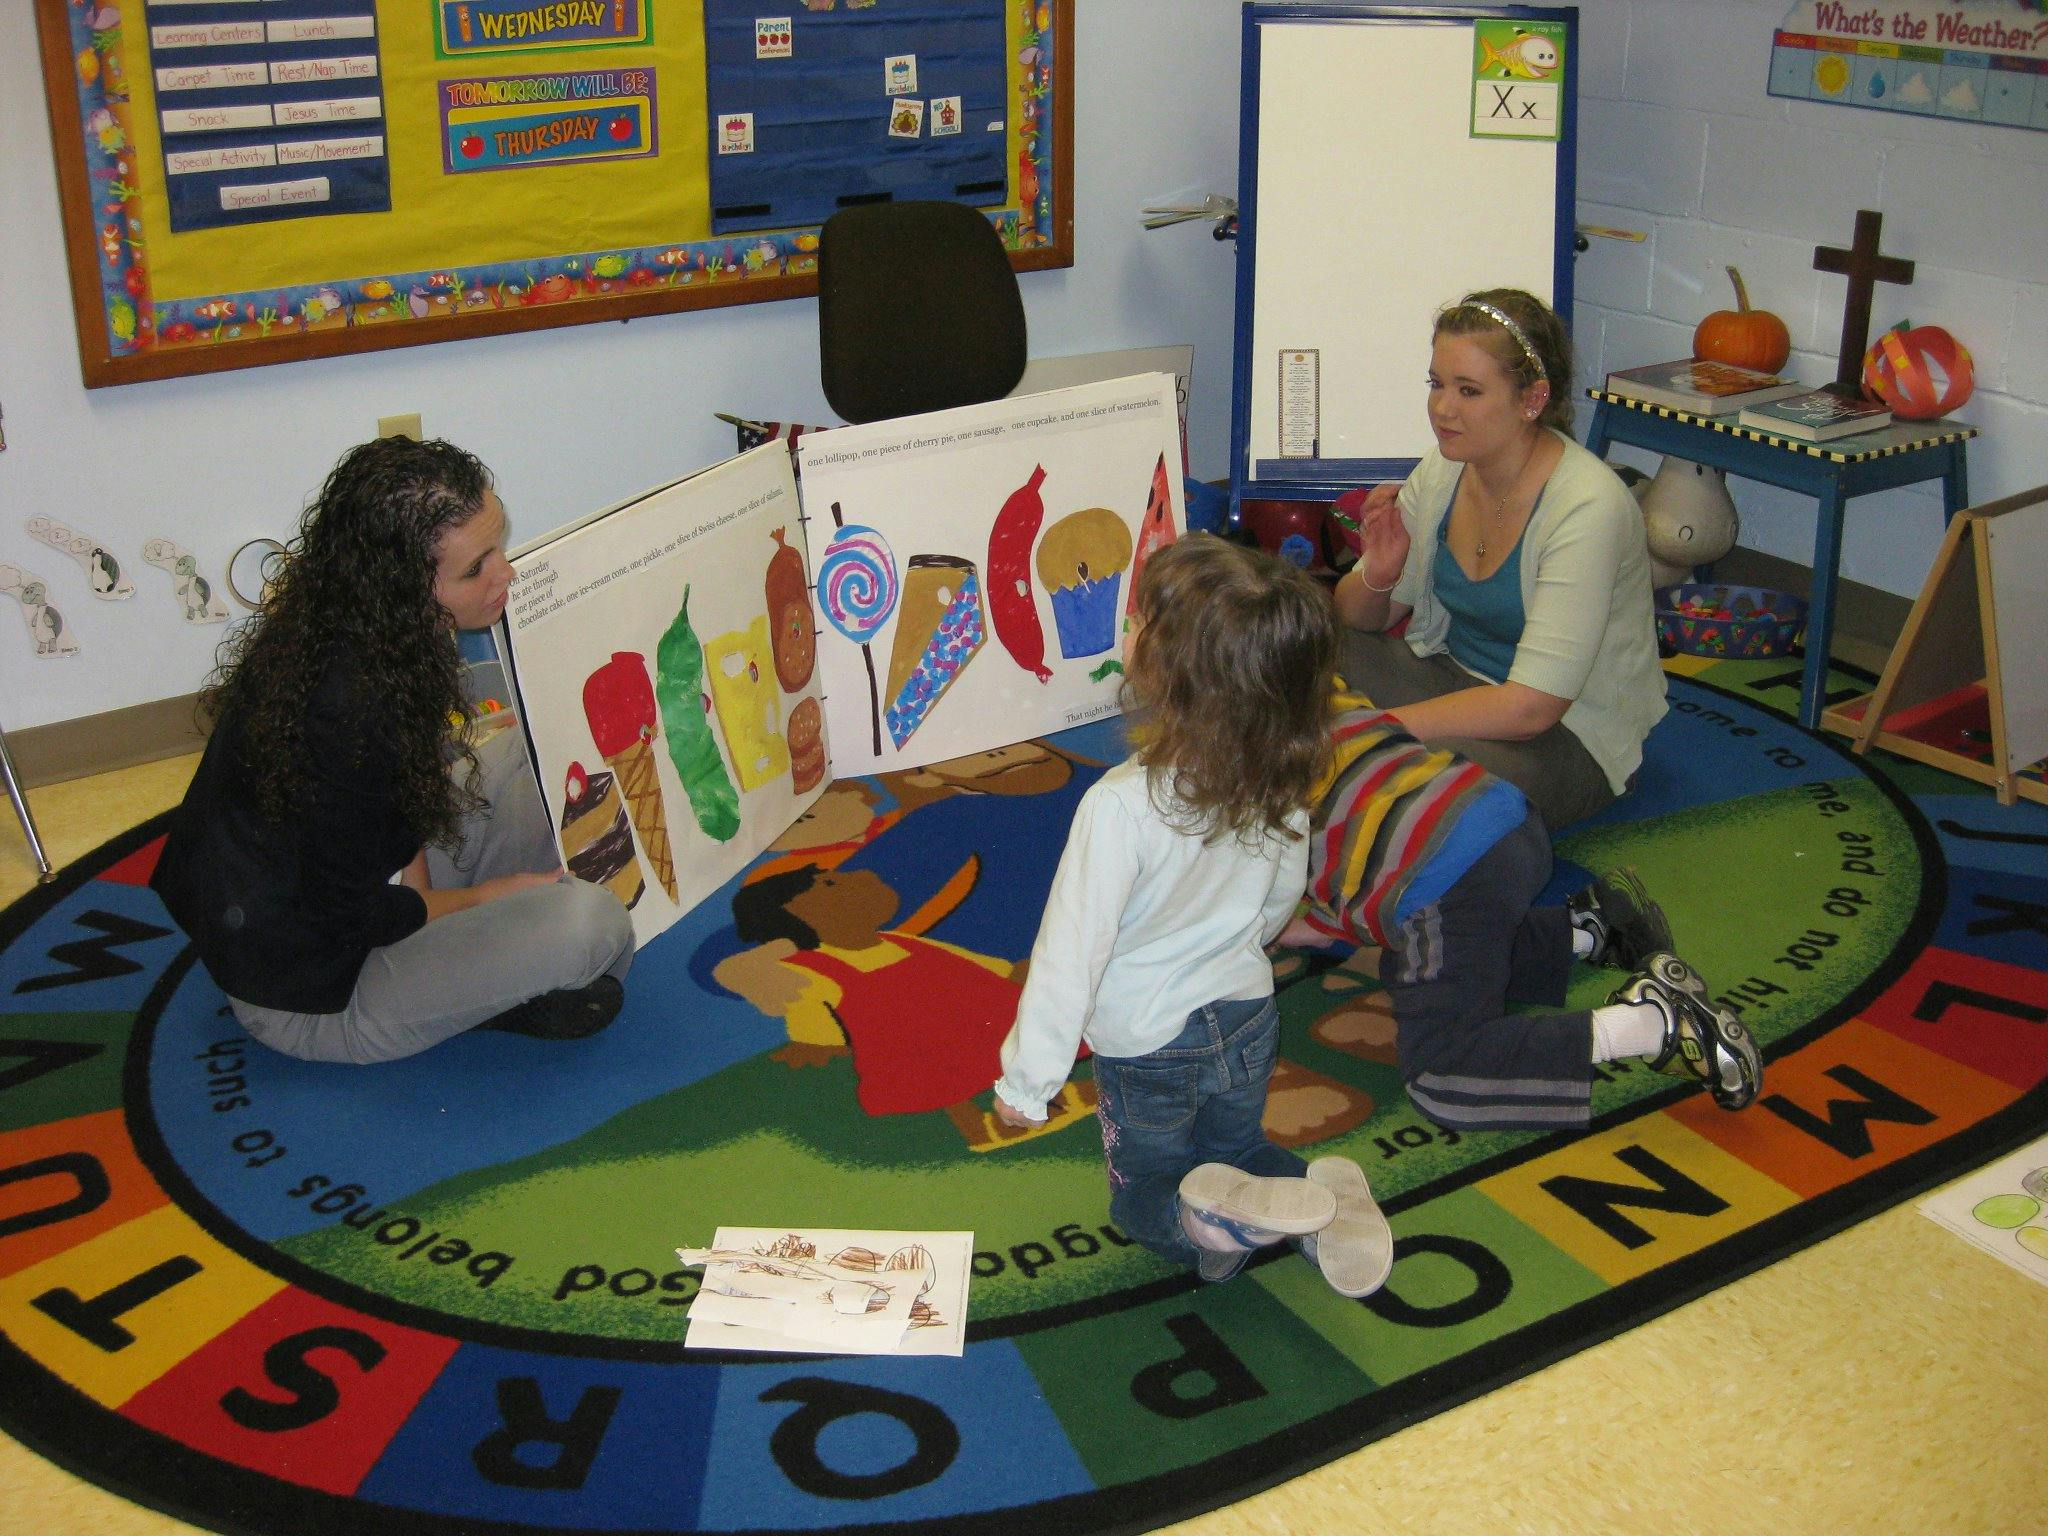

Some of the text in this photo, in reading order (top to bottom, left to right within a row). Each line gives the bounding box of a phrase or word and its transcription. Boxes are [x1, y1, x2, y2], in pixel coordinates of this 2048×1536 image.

[156, 26, 262, 46] Learning Centers
[293, 22, 336, 38] Lunch
[479, 3, 606, 39] WEDNESDAY
[757, 22, 790, 33] Parent
[1816, 1, 1884, 36] What's
[1892, 11, 1928, 40] the
[165, 67, 256, 88] Carpet Time
[278, 59, 369, 80] Rest/Nap Time
[447, 76, 570, 106] TOMORROW
[572, 74, 620, 97] WILL
[189, 113, 231, 127] Snack
[284, 102, 356, 121] Jesus Time
[279, 141, 374, 160] Music/Movement
[495, 116, 599, 157] THURSDAY
[174, 149, 267, 171] Special Activity
[231, 187, 319, 208] Special Event
[808, 398, 1162, 467] one lollipop, one piece of cherry pie, one sausage, one cupcake, and one slice of watermelon.
[509, 560, 550, 588] On Saturday
[517, 609, 549, 630] chocolate
[549, 598, 566, 613] cake,
[566, 591, 579, 603] one
[579, 574, 611, 597] ice-cream
[611, 565, 630, 580] cone,
[630, 558, 643, 570] one
[643, 547, 664, 566] pickle,
[665, 541, 677, 553] one
[677, 532, 691, 546] slice
[691, 526, 699, 539] of
[698, 521, 716, 536] Swiss
[716, 512, 738, 528] cheese,
[737, 506, 748, 516] one
[748, 500, 760, 512] slice
[760, 494, 767, 505] of
[511, 570, 559, 602] he ate through
[515, 586, 554, 616] one piece of
[1065, 712, 1083, 724] That
[1084, 705, 1103, 719] night
[1104, 704, 1113, 712] he
[1765, 747, 1806, 769] to
[1804, 782, 1850, 817] me,
[1836, 830, 1886, 876] and
[1822, 887, 1873, 918] do
[1774, 929, 1841, 972] not
[193, 1037, 252, 1114] such
[1759, 1063, 1940, 1160] M
[230, 1127, 287, 1169] to
[1538, 1144, 1732, 1252] N
[288, 1173, 515, 1289] belongs
[29, 1254, 205, 1353] T
[219, 1326, 389, 1432] S
[1130, 1310, 1270, 1420] P
[471, 1376, 623, 1490] R
[757, 1375, 961, 1500] Q
